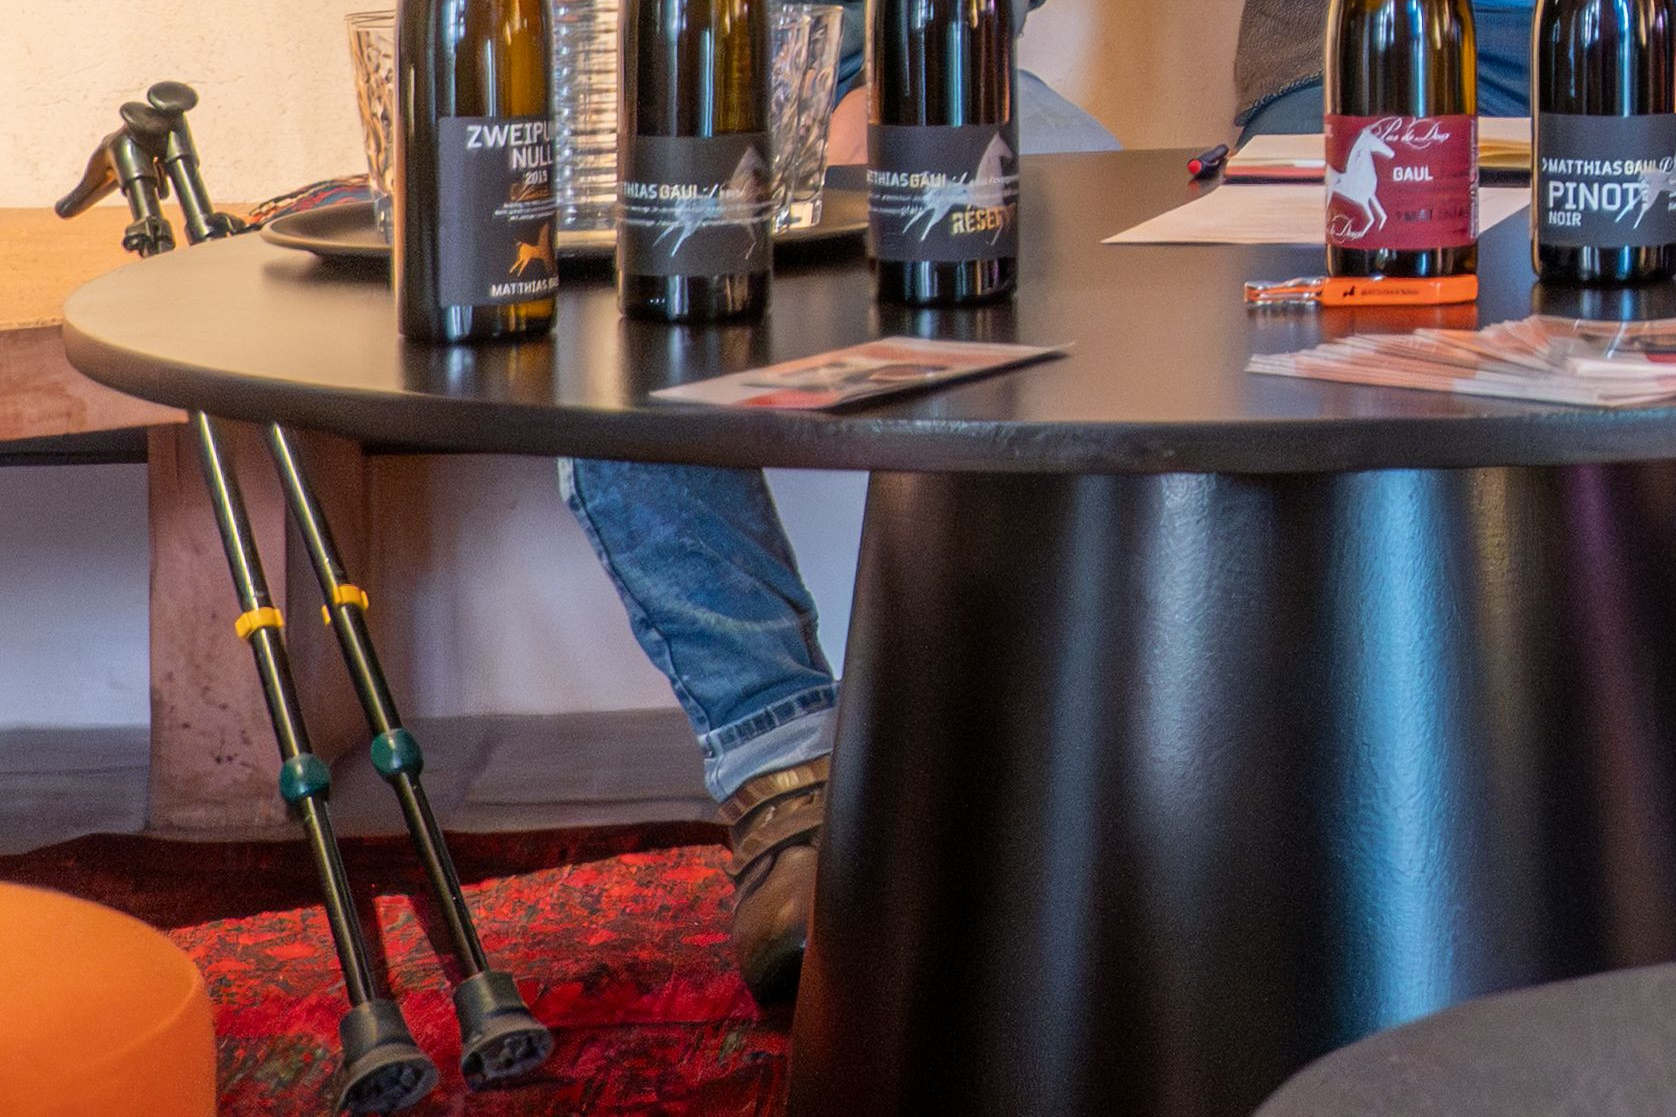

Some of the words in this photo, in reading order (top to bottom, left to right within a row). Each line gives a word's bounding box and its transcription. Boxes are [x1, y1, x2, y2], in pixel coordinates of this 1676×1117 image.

[1547, 158, 1623, 175] MATTHIAS
[1548, 181, 1643, 211] PINOT
[1548, 211, 1582, 227] NOIR
